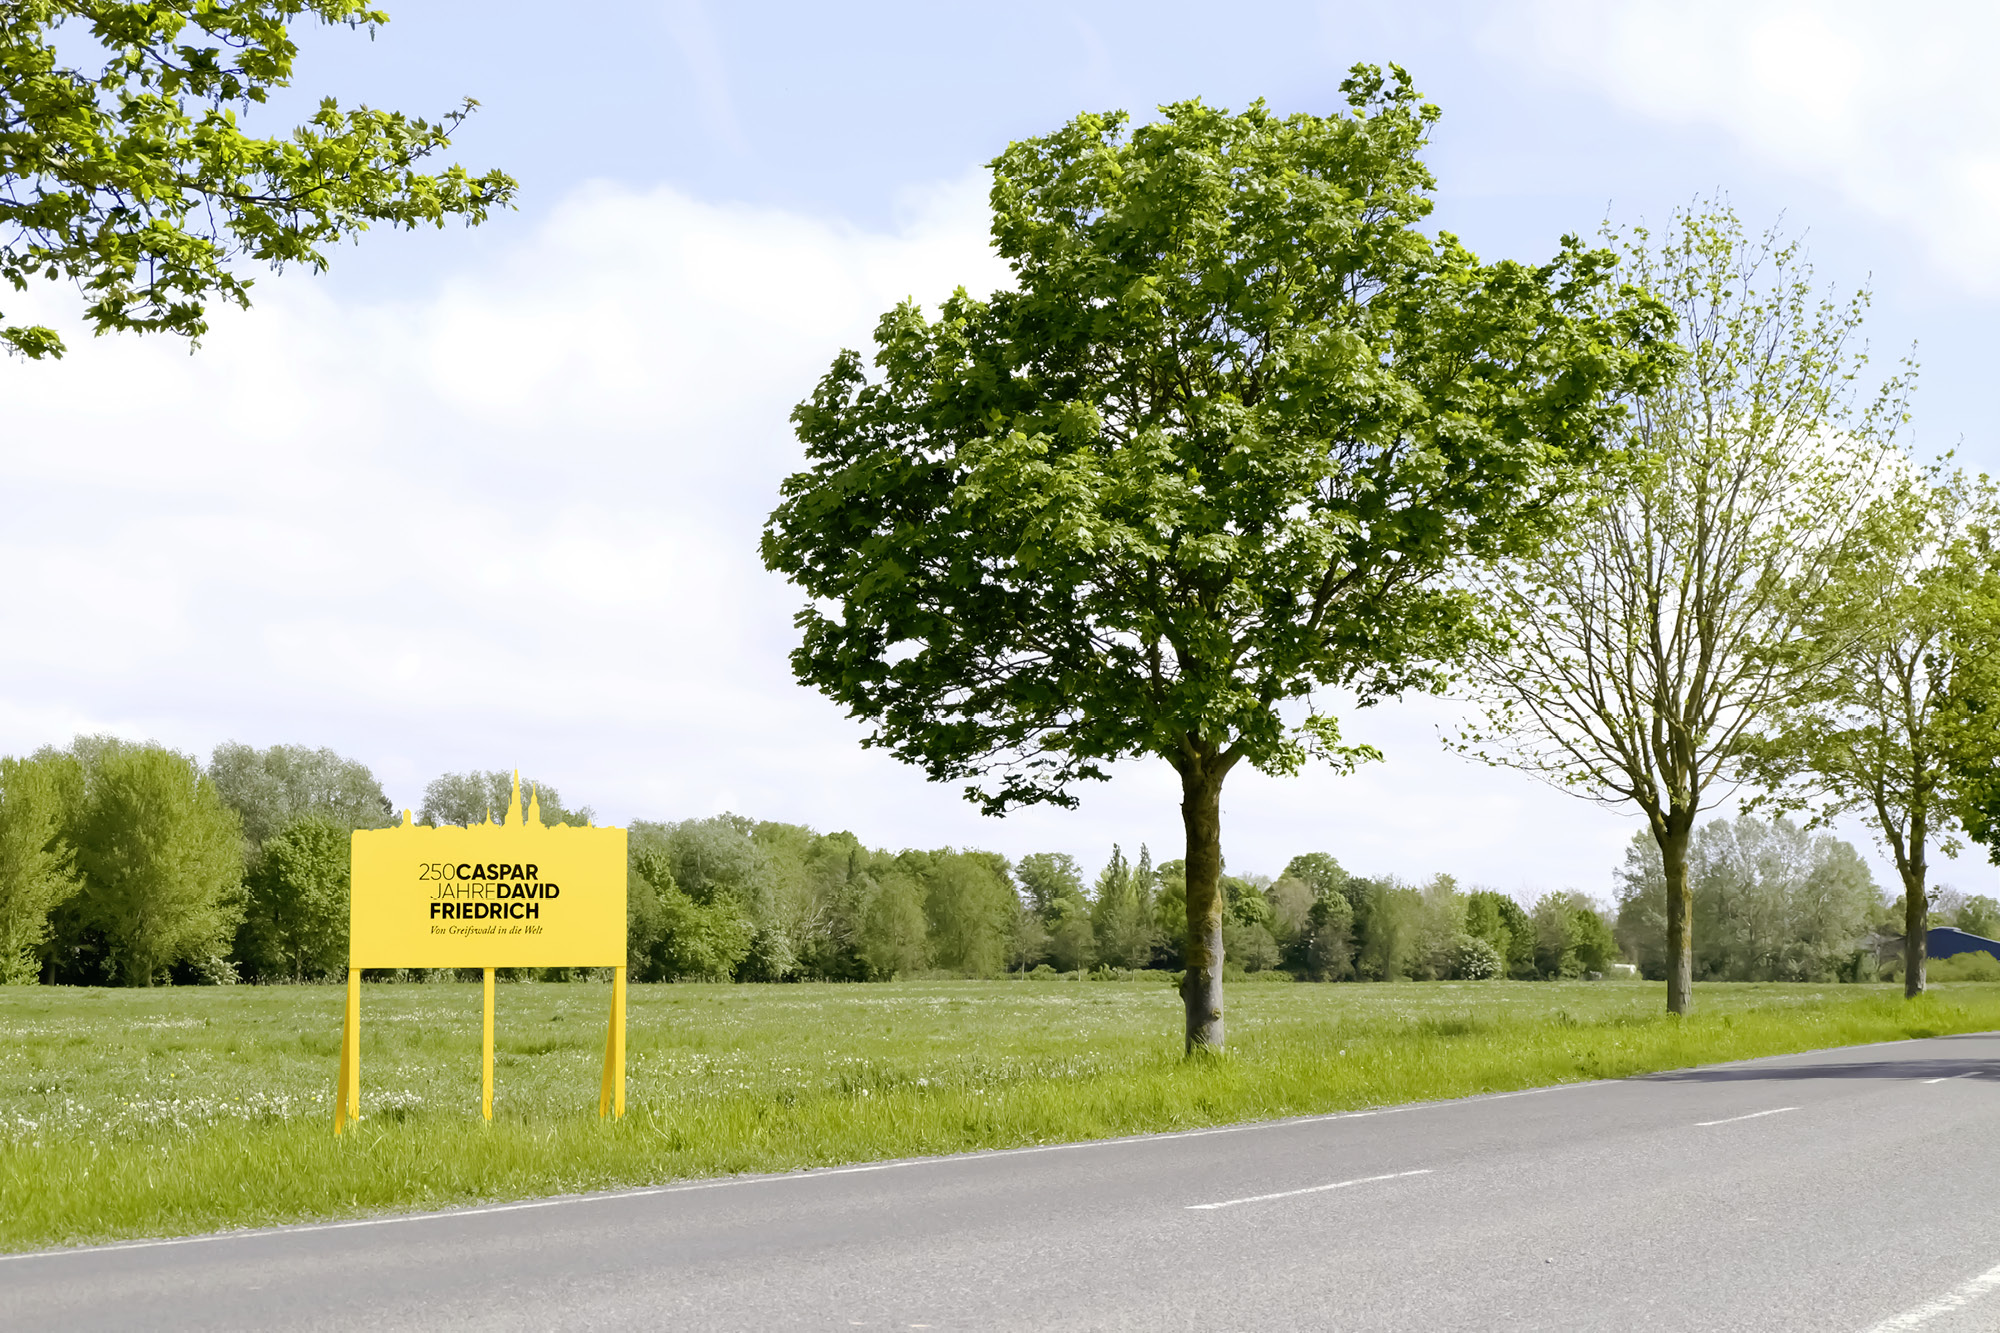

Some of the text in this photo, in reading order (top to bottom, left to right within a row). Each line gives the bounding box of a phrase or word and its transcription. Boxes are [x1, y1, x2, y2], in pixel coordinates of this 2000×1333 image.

[430, 902, 539, 919] FRIEDRICH
[430, 925, 543, 938] Von Greifswald in die Welt
